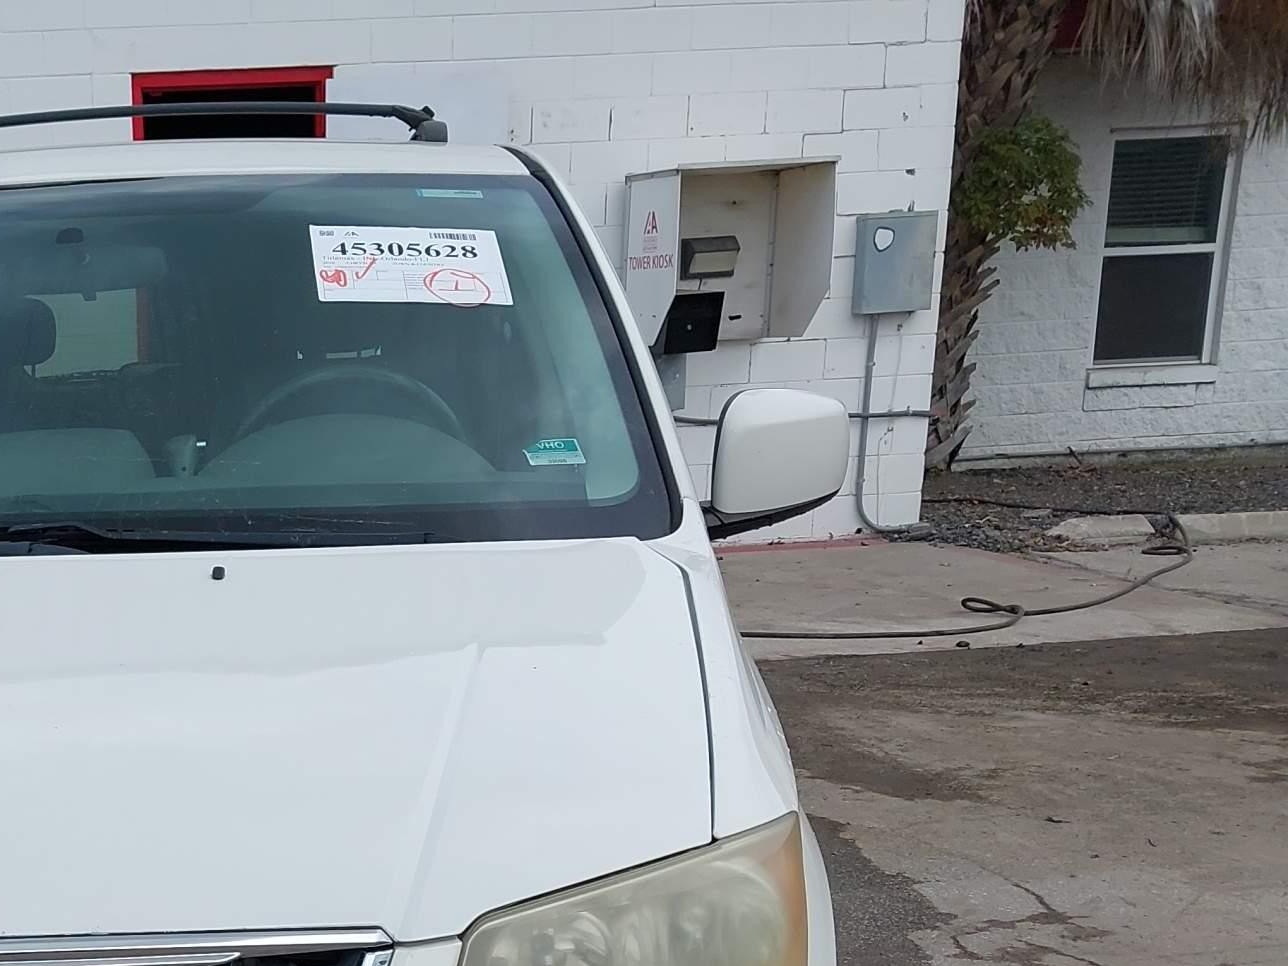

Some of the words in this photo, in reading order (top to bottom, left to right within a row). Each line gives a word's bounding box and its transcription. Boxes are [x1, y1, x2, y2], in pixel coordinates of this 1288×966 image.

[332, 241, 478, 259] 45305628
[628, 256, 651, 271] TOWER
[652, 254, 673, 269] KIOSK
